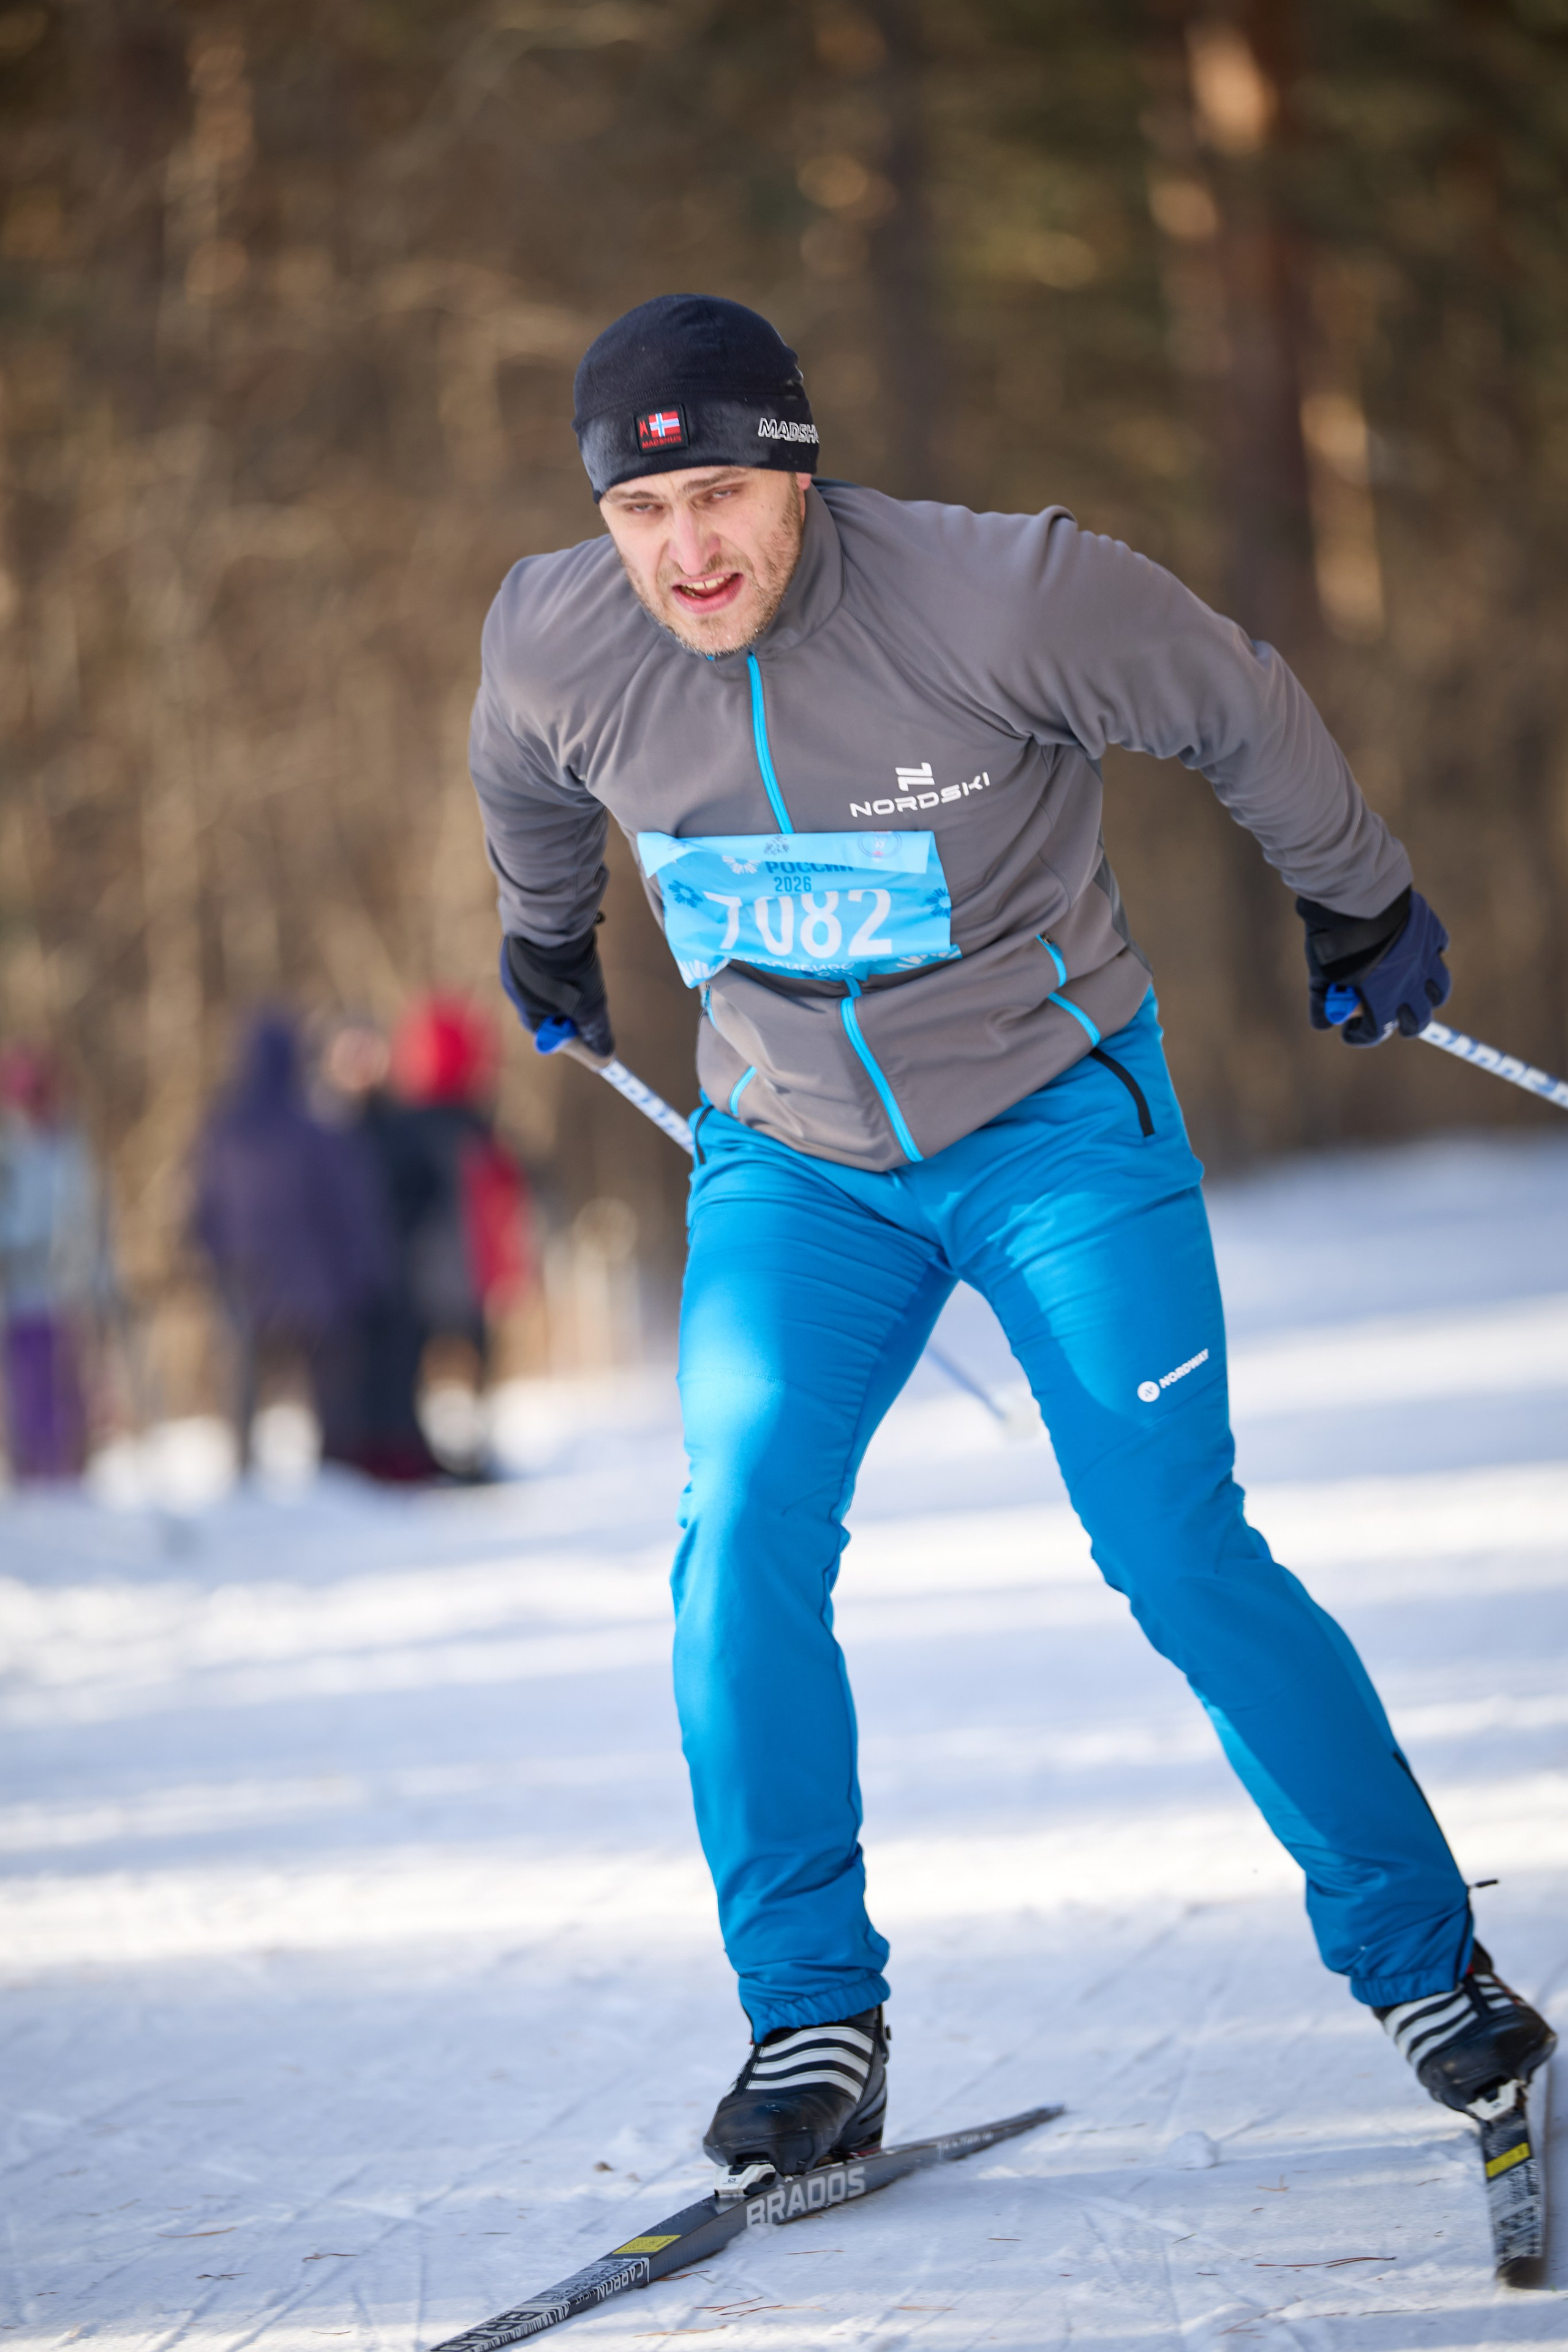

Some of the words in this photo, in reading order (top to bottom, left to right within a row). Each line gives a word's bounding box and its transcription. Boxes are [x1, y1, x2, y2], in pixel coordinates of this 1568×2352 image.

[849, 771, 990, 818] NORDSKI
[774, 876, 812, 892] 2026
[703, 889, 893, 959] 7082
[747, 2166, 865, 2227] BRADOS
